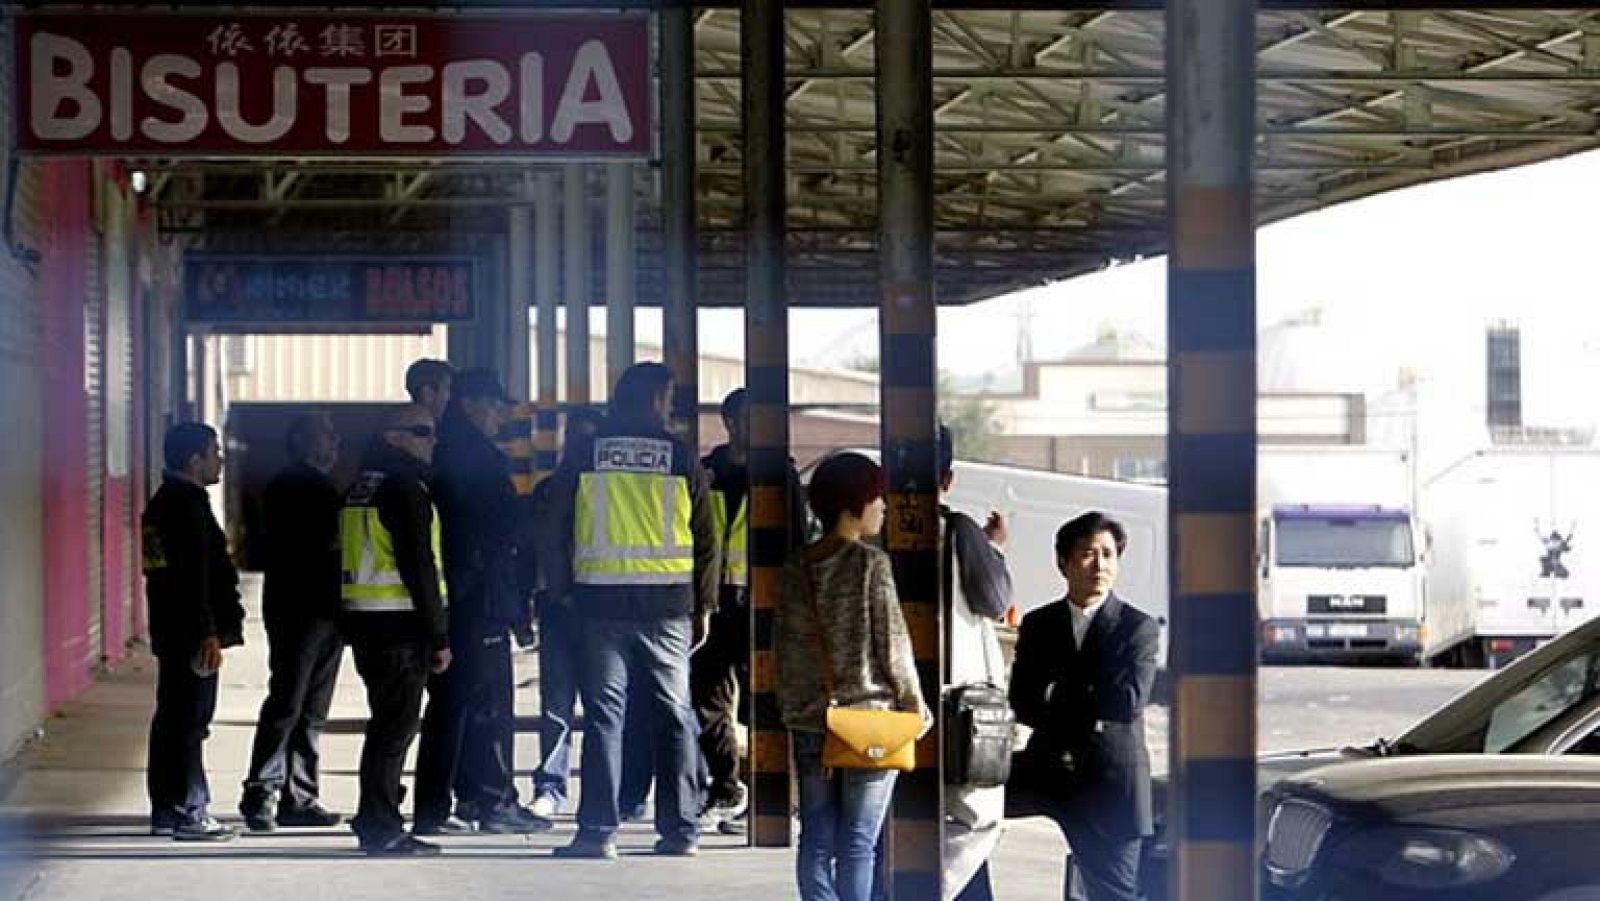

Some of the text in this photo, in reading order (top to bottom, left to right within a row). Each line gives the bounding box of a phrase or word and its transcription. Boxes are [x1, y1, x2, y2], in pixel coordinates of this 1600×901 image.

[205, 22, 418, 58] 依依集团
[30, 32, 634, 145] BISUTERIA
